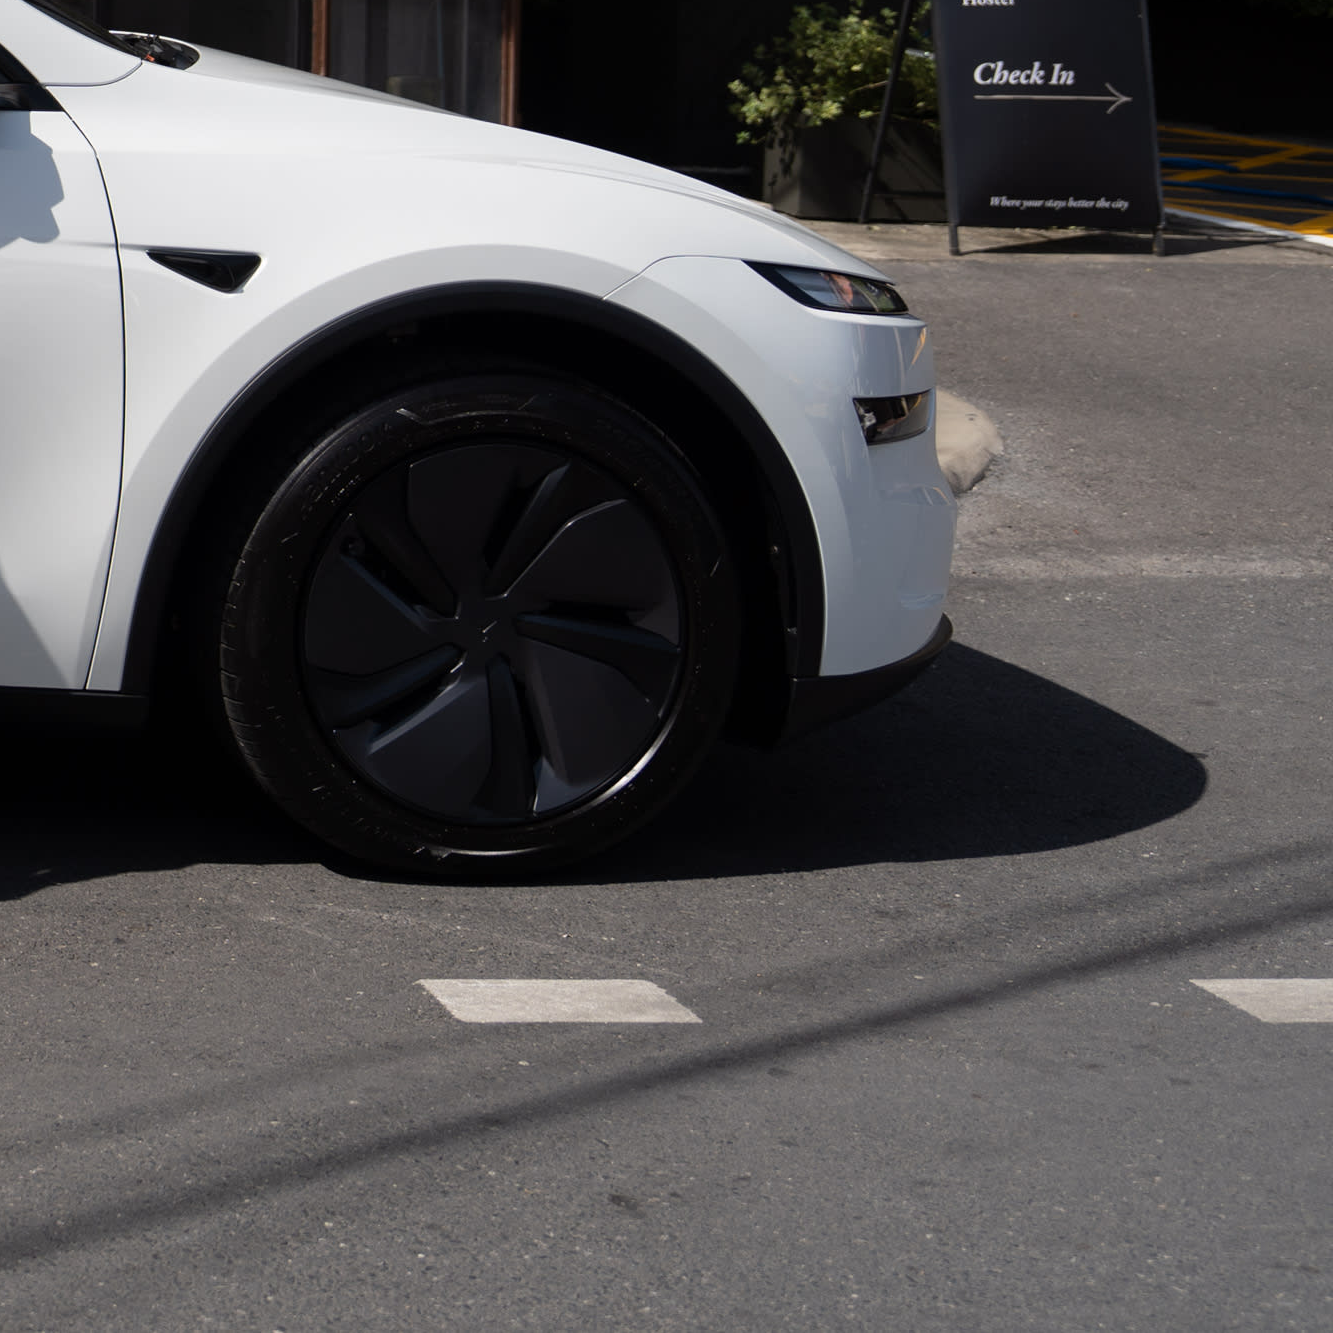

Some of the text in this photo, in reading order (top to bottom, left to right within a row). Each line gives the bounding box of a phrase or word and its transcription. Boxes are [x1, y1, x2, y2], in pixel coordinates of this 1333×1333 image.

[973, 61, 1076, 85] Check In
[989, 196, 1021, 207] Where
